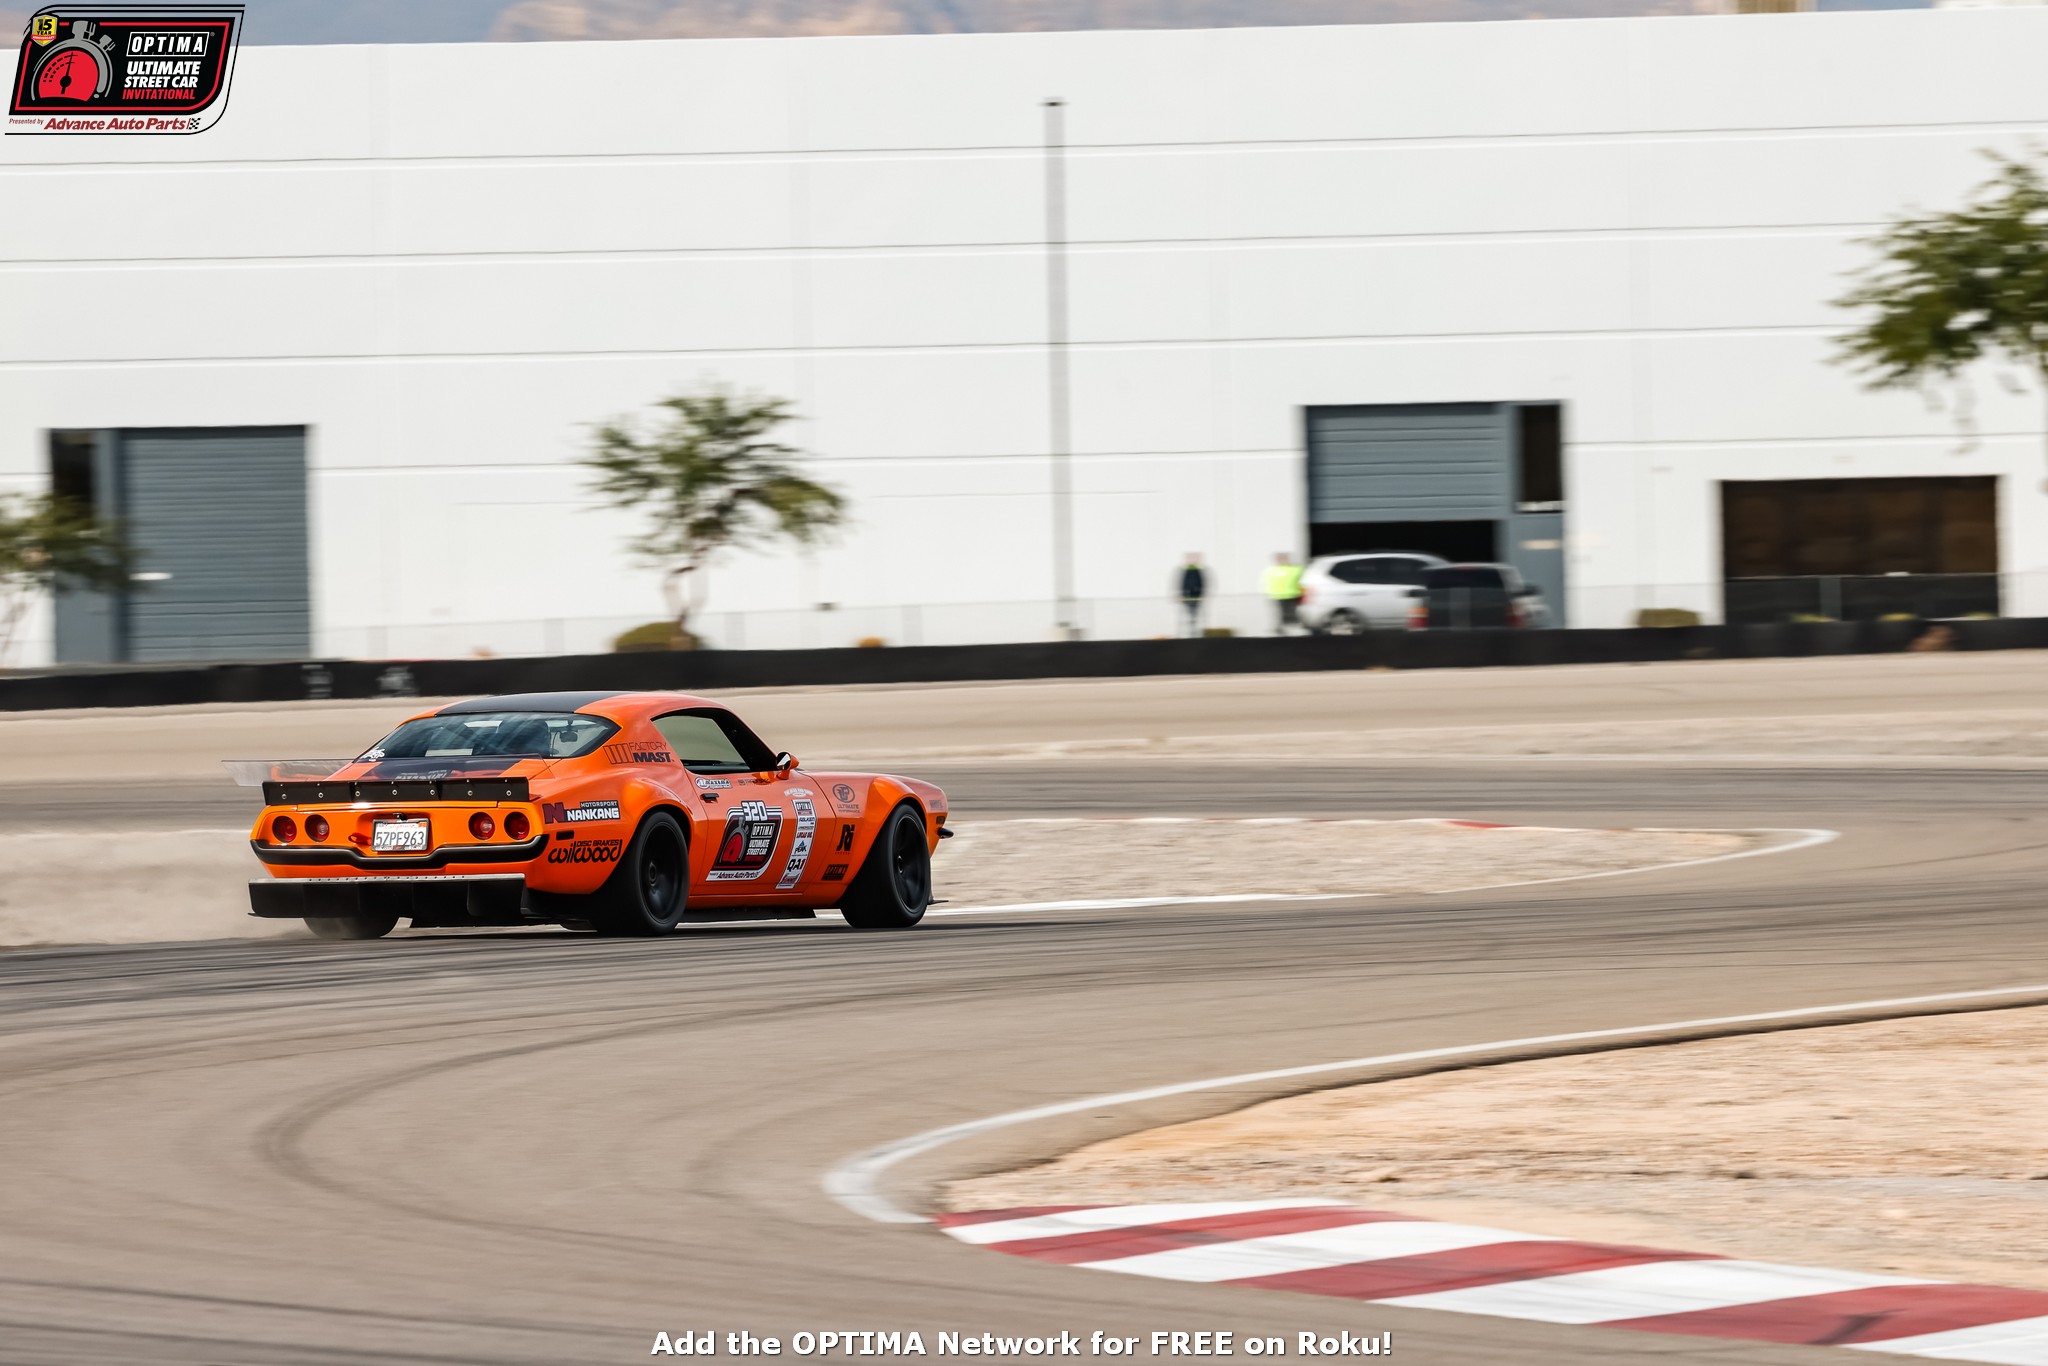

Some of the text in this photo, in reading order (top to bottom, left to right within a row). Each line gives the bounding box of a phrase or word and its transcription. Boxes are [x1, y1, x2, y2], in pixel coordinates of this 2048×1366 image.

[630, 741, 668, 751] FACTORY
[632, 752, 671, 762] MAST
[580, 800, 618, 808] MOTORSPORT
[566, 807, 620, 822] NANKANG
[742, 801, 768, 821] 320
[752, 825, 774, 836] OPTIMA
[592, 839, 619, 847] BRAKES
[749, 839, 771, 848] ULTIMATE
[547, 839, 623, 864] wilwood
[787, 859, 806, 872] QA1
